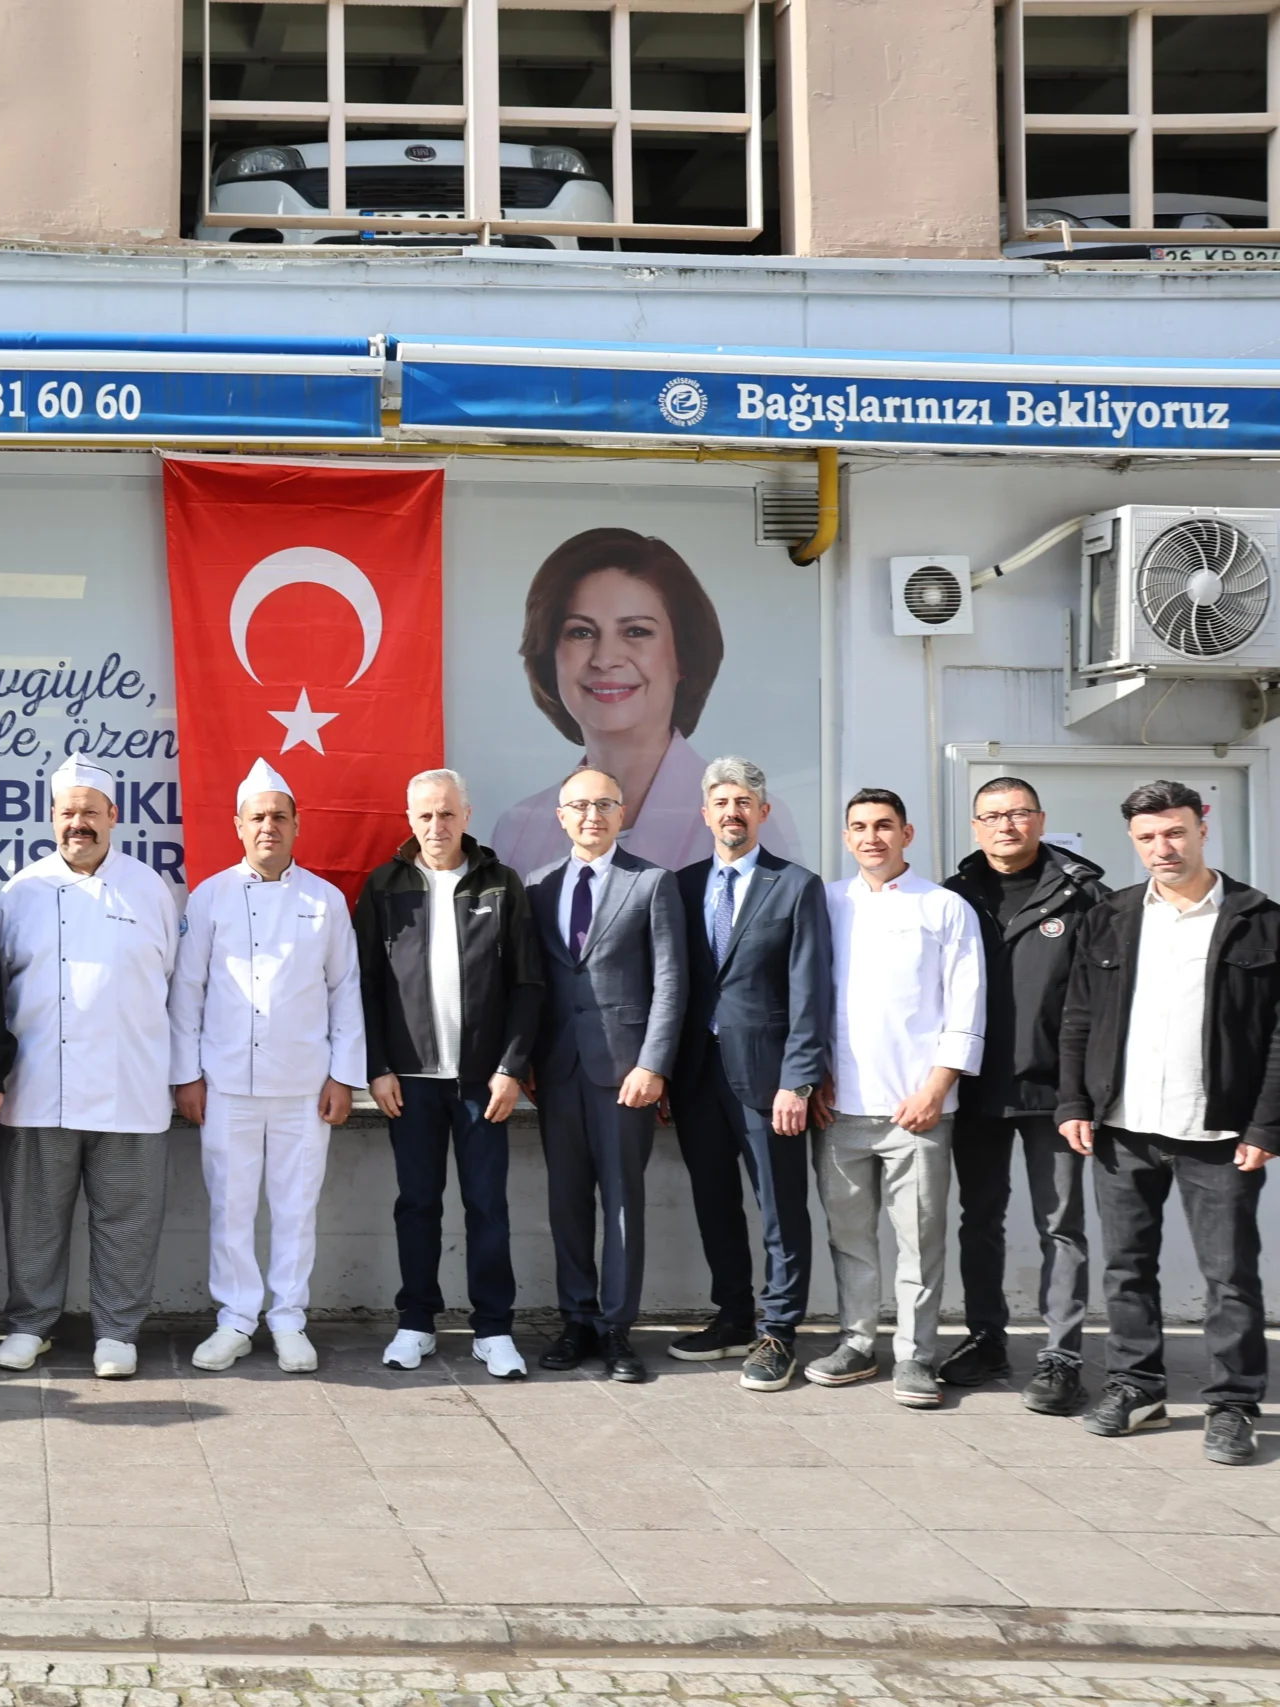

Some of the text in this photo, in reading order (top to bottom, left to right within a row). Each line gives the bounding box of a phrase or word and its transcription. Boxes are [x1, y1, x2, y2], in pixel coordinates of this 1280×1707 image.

[37, 381, 83, 420] 60
[95, 383, 141, 421] 60
[665, 376, 701, 390] ESKİŞEHİR
[737, 383, 1230, 439] Bağışlarınızı Bekliyoruz
